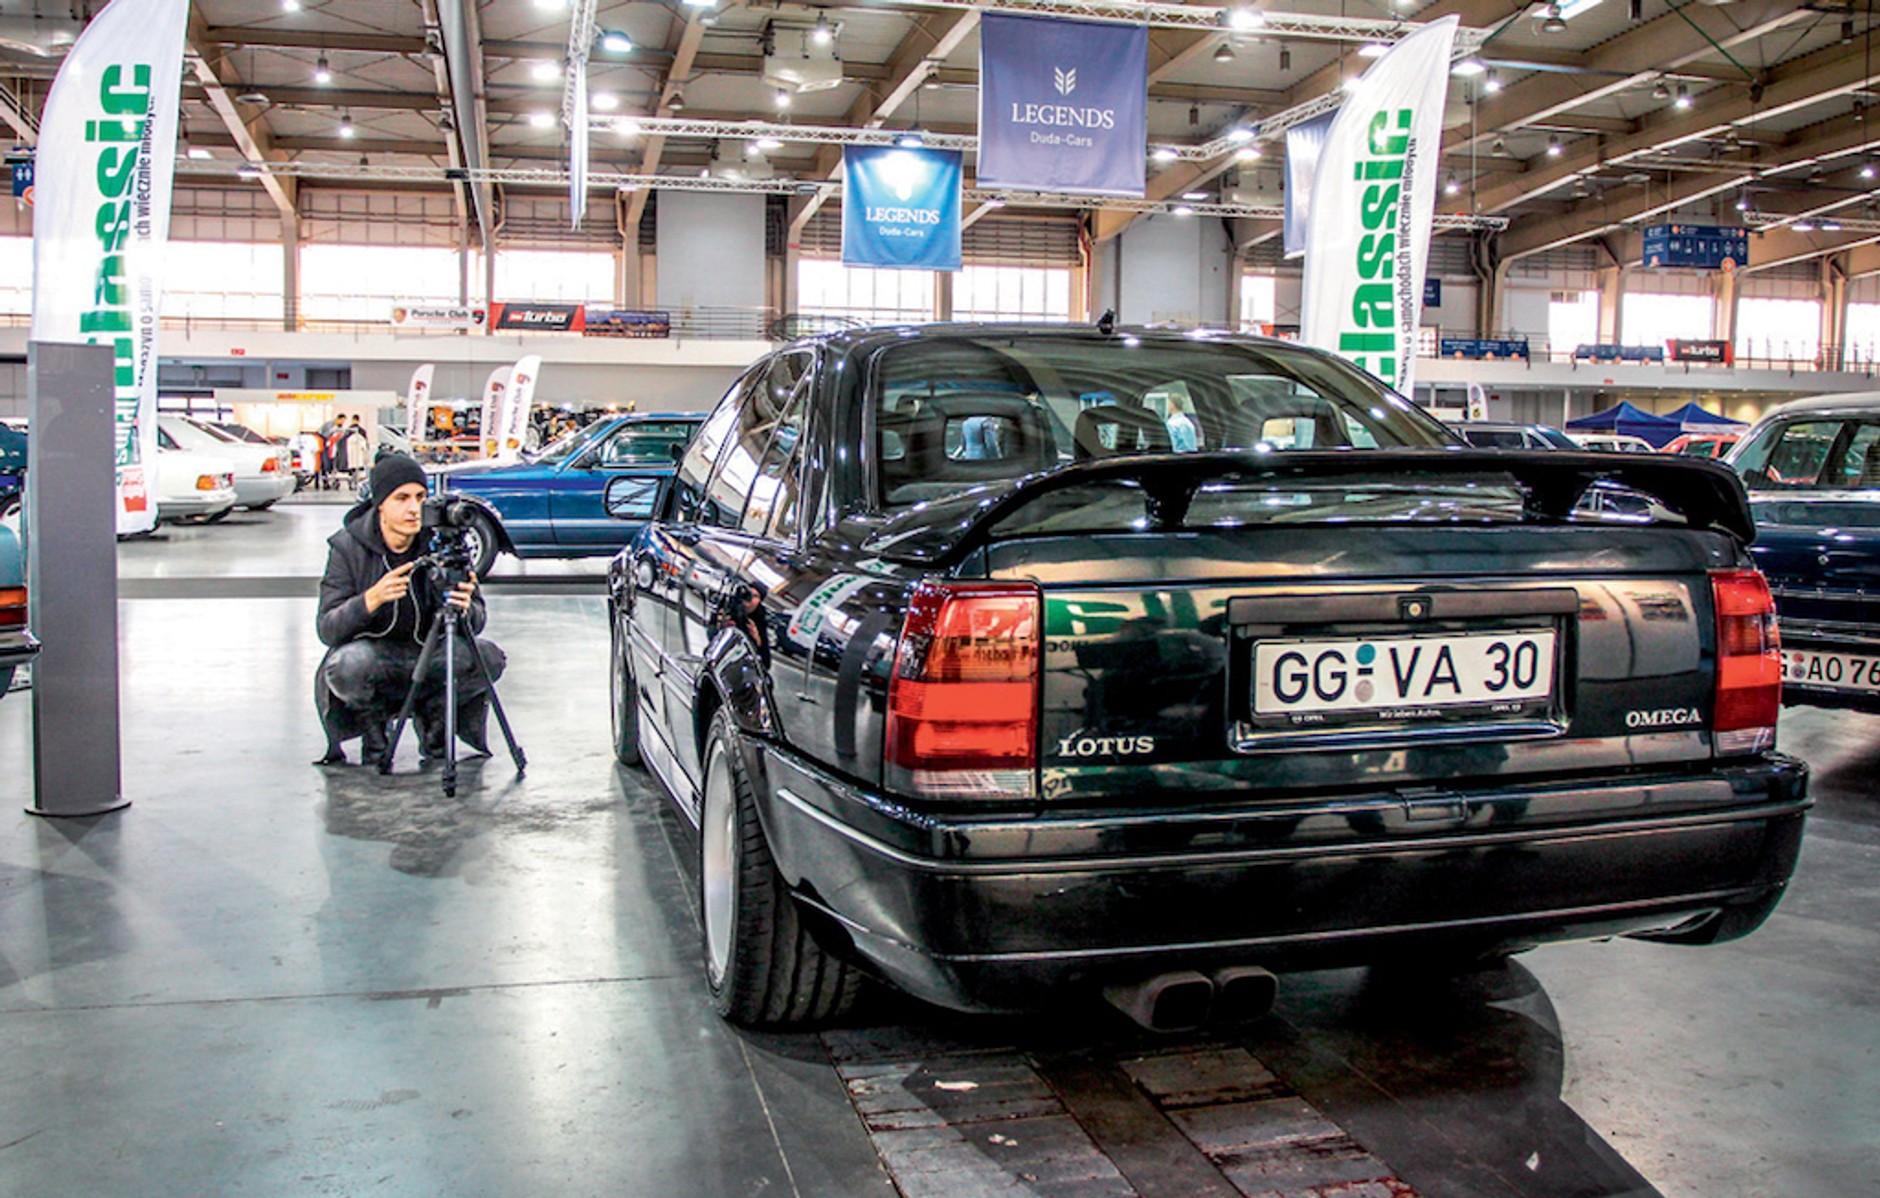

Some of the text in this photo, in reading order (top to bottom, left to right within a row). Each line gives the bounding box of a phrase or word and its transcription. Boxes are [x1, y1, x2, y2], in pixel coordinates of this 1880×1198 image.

[1012, 103, 1115, 129] LEGENDS
[1031, 131, 1093, 148] Duda-Cars
[133, 157, 152, 218] wiecznie
[866, 207, 940, 225] LEGENDS
[1397, 194, 1413, 249] wiecznie
[879, 226, 924, 237] Duda-Cars
[1395, 251, 1414, 333] samochodach
[1484, 641, 1539, 691] 30
[1625, 708, 1702, 728] OMEGA
[1058, 736, 1154, 757] LOTUS
